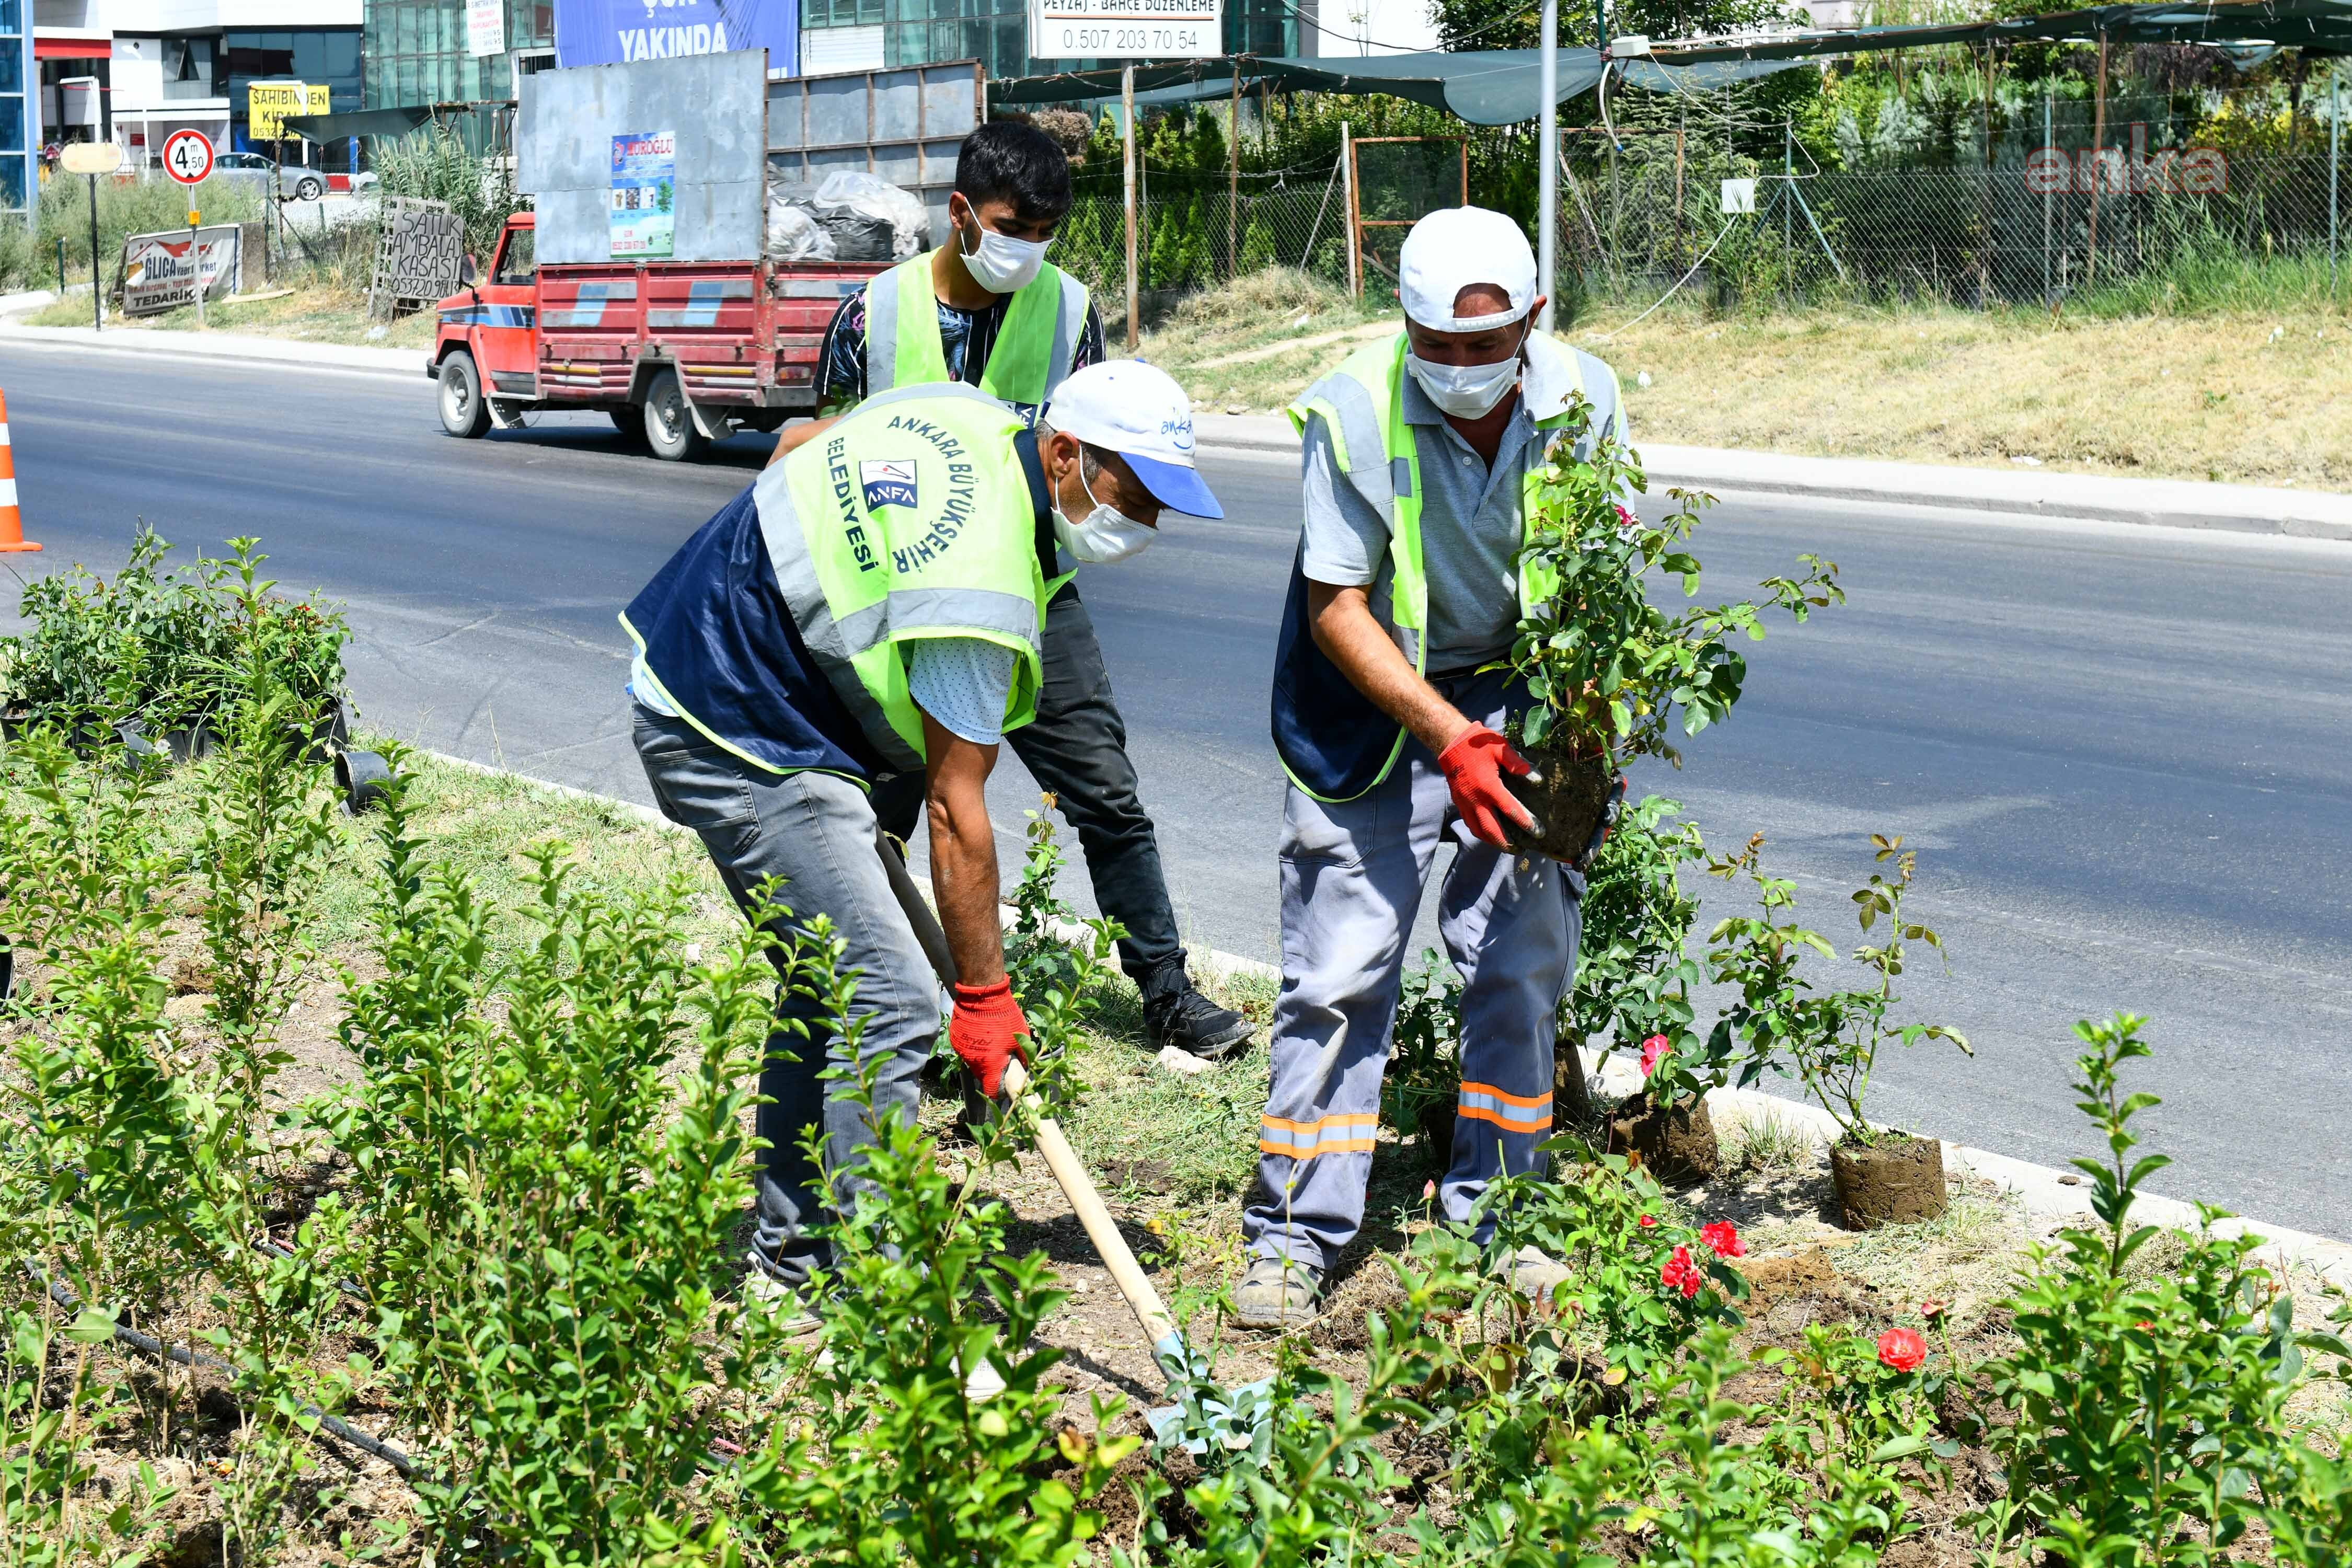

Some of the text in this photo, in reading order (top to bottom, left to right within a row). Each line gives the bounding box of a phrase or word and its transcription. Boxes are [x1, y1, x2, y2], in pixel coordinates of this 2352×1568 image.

[1045, 0, 1087, 13] PEYZAJ
[617, 22, 728, 62] YAKINDA
[1064, 30, 1197, 49] 0.507 203 70 54
[401, 211, 462, 238] SATLIK
[392, 232, 462, 259] AMBALAJ
[827, 416, 979, 573] ANKARA BÜYÜKŞEHİR BELEDİYESİ
[868, 486, 915, 506] ANFA
